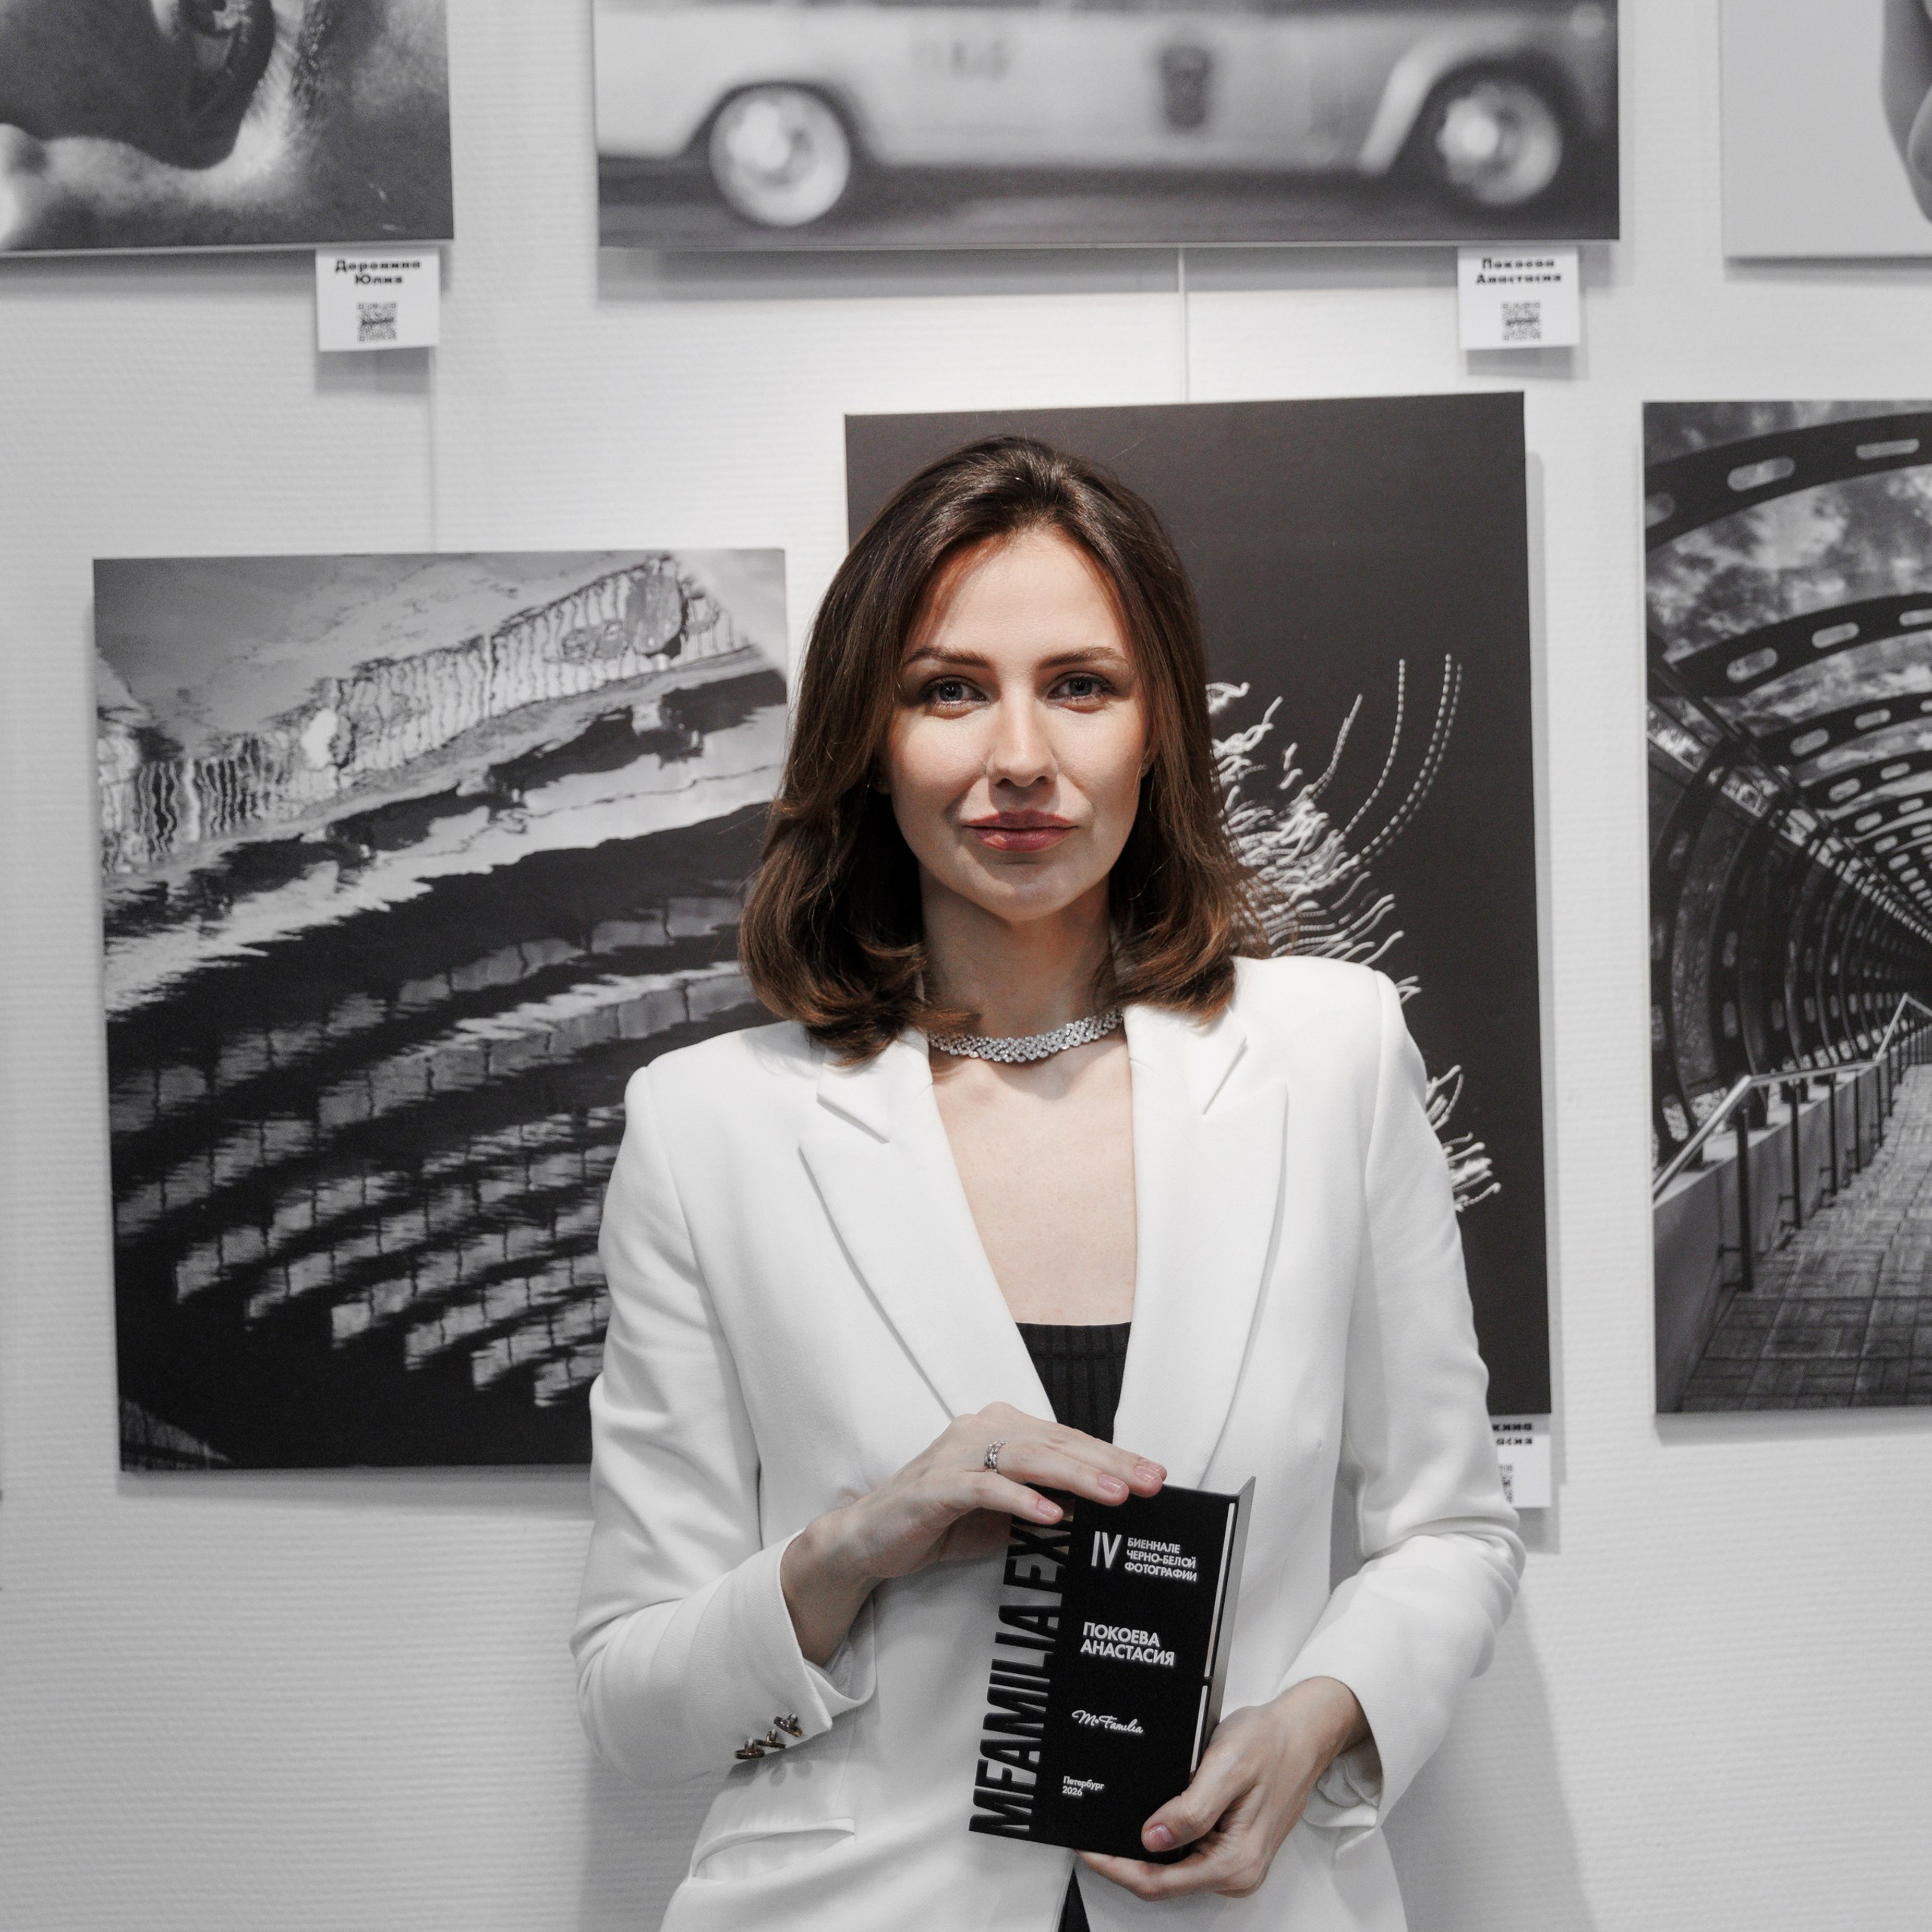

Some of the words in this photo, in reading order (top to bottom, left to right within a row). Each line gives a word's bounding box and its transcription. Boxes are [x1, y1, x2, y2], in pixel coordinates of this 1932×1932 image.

[355, 274, 403, 284] Юлия
[1091, 1531, 1122, 1569] IV
[1128, 1537, 1180, 1554] БИЕННАЛЕ
[1126, 1549, 1196, 1568] ЧЕРНО-БЕЛОЙ
[1124, 1562, 1198, 1581] ФОТОГРАФИИ
[1083, 1622, 1160, 1647] ПОКОЕВА
[1080, 1639, 1175, 1666] АНАСТАСИЯ
[1062, 1786, 1083, 1797] 2026
[1063, 1776, 1105, 1791] Петербург
